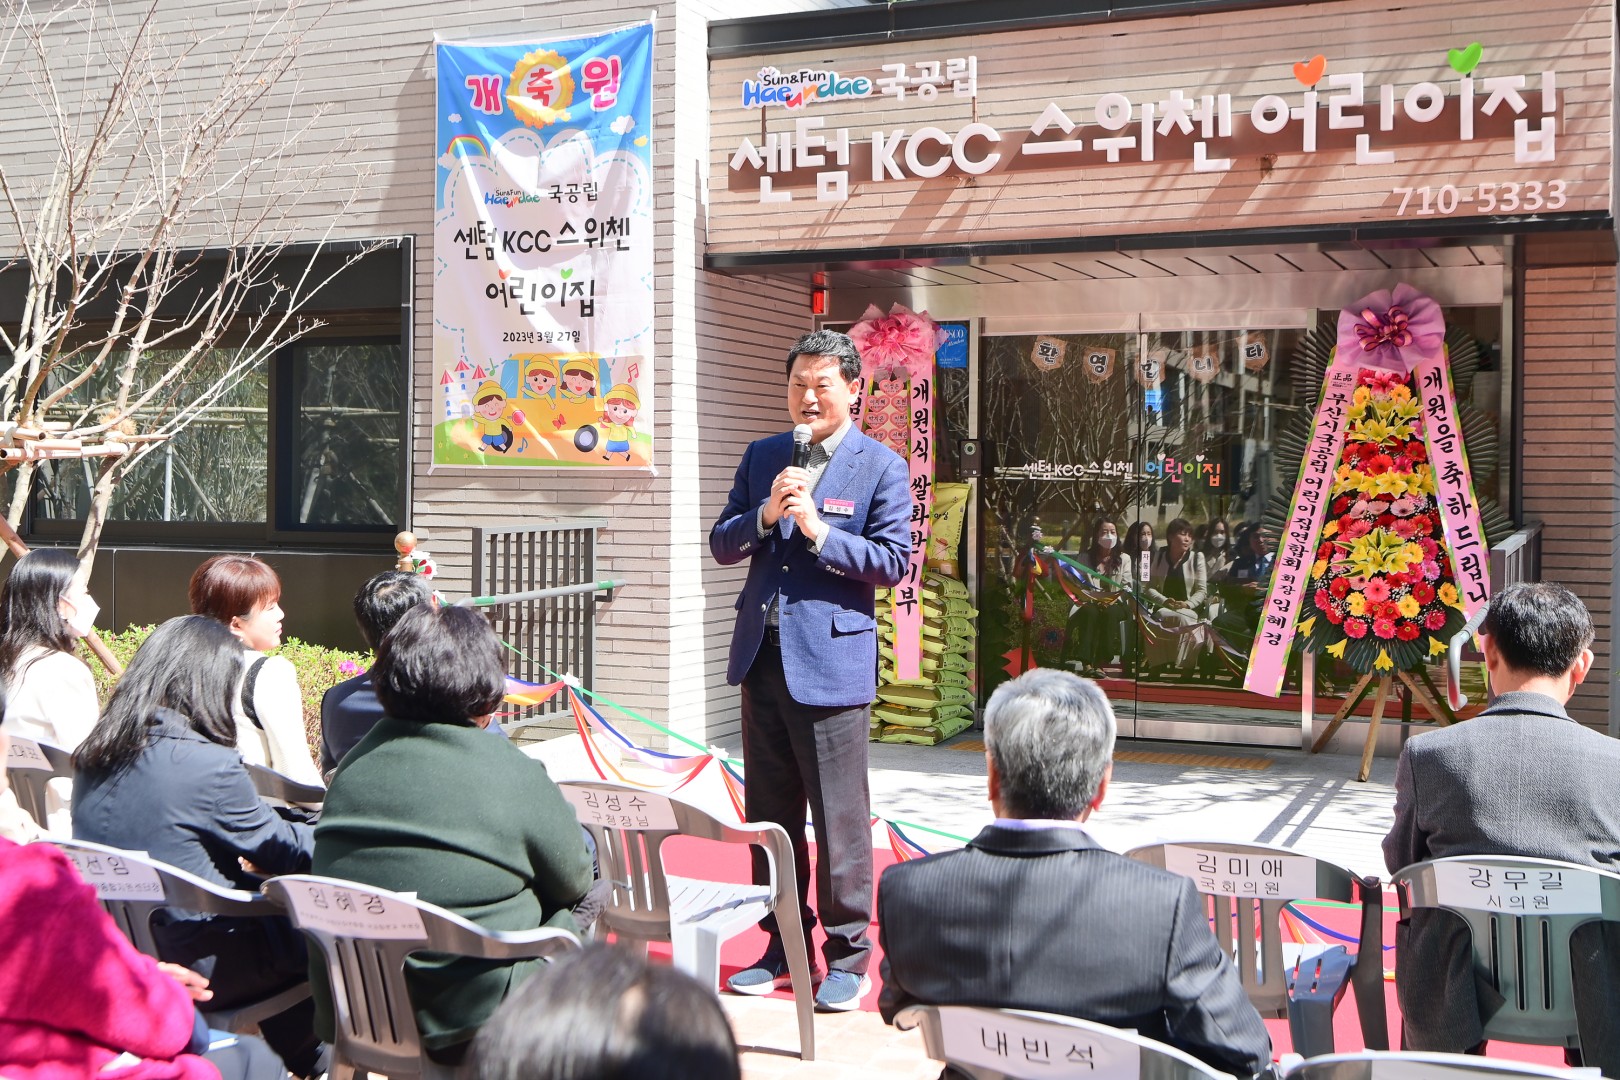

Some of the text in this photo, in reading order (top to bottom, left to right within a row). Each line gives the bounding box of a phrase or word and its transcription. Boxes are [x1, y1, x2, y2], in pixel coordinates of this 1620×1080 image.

[466, 58, 620, 114] 개 축 원
[743, 55, 978, 107] Haeundae 국공립
[763, 71, 827, 87] Sun&Fun
[730, 71, 1556, 203] 센텀 KCC 스위첸 어린이집
[548, 181, 598, 204] 국공립
[1393, 179, 1567, 216] 710-5333
[453, 217, 630, 261] 센텀 KCC 스위첸
[485, 277, 595, 317] 어린이집
[503, 330, 581, 343] 2023년 3월 27일
[911, 378, 930, 464] 개원식
[1423, 366, 1456, 452] 개원을
[1309, 393, 1349, 474] 부산시국공립
[1023, 457, 1221, 487] 센텀 KCC 스위첸 어린이집
[1279, 574, 1296, 596] 회장
[1264, 598, 1291, 646] 임혜경
[582, 790, 647, 812] 김성수
[592, 811, 649, 827] 구청장님
[1196, 853, 1283, 878] 김미애
[1468, 867, 1563, 891] 강무길
[308, 887, 385, 915] 임혜경
[1200, 876, 1280, 896] 국회의원
[1486, 894, 1550, 910] 시의원
[981, 1026, 1095, 1070] 내빈석
